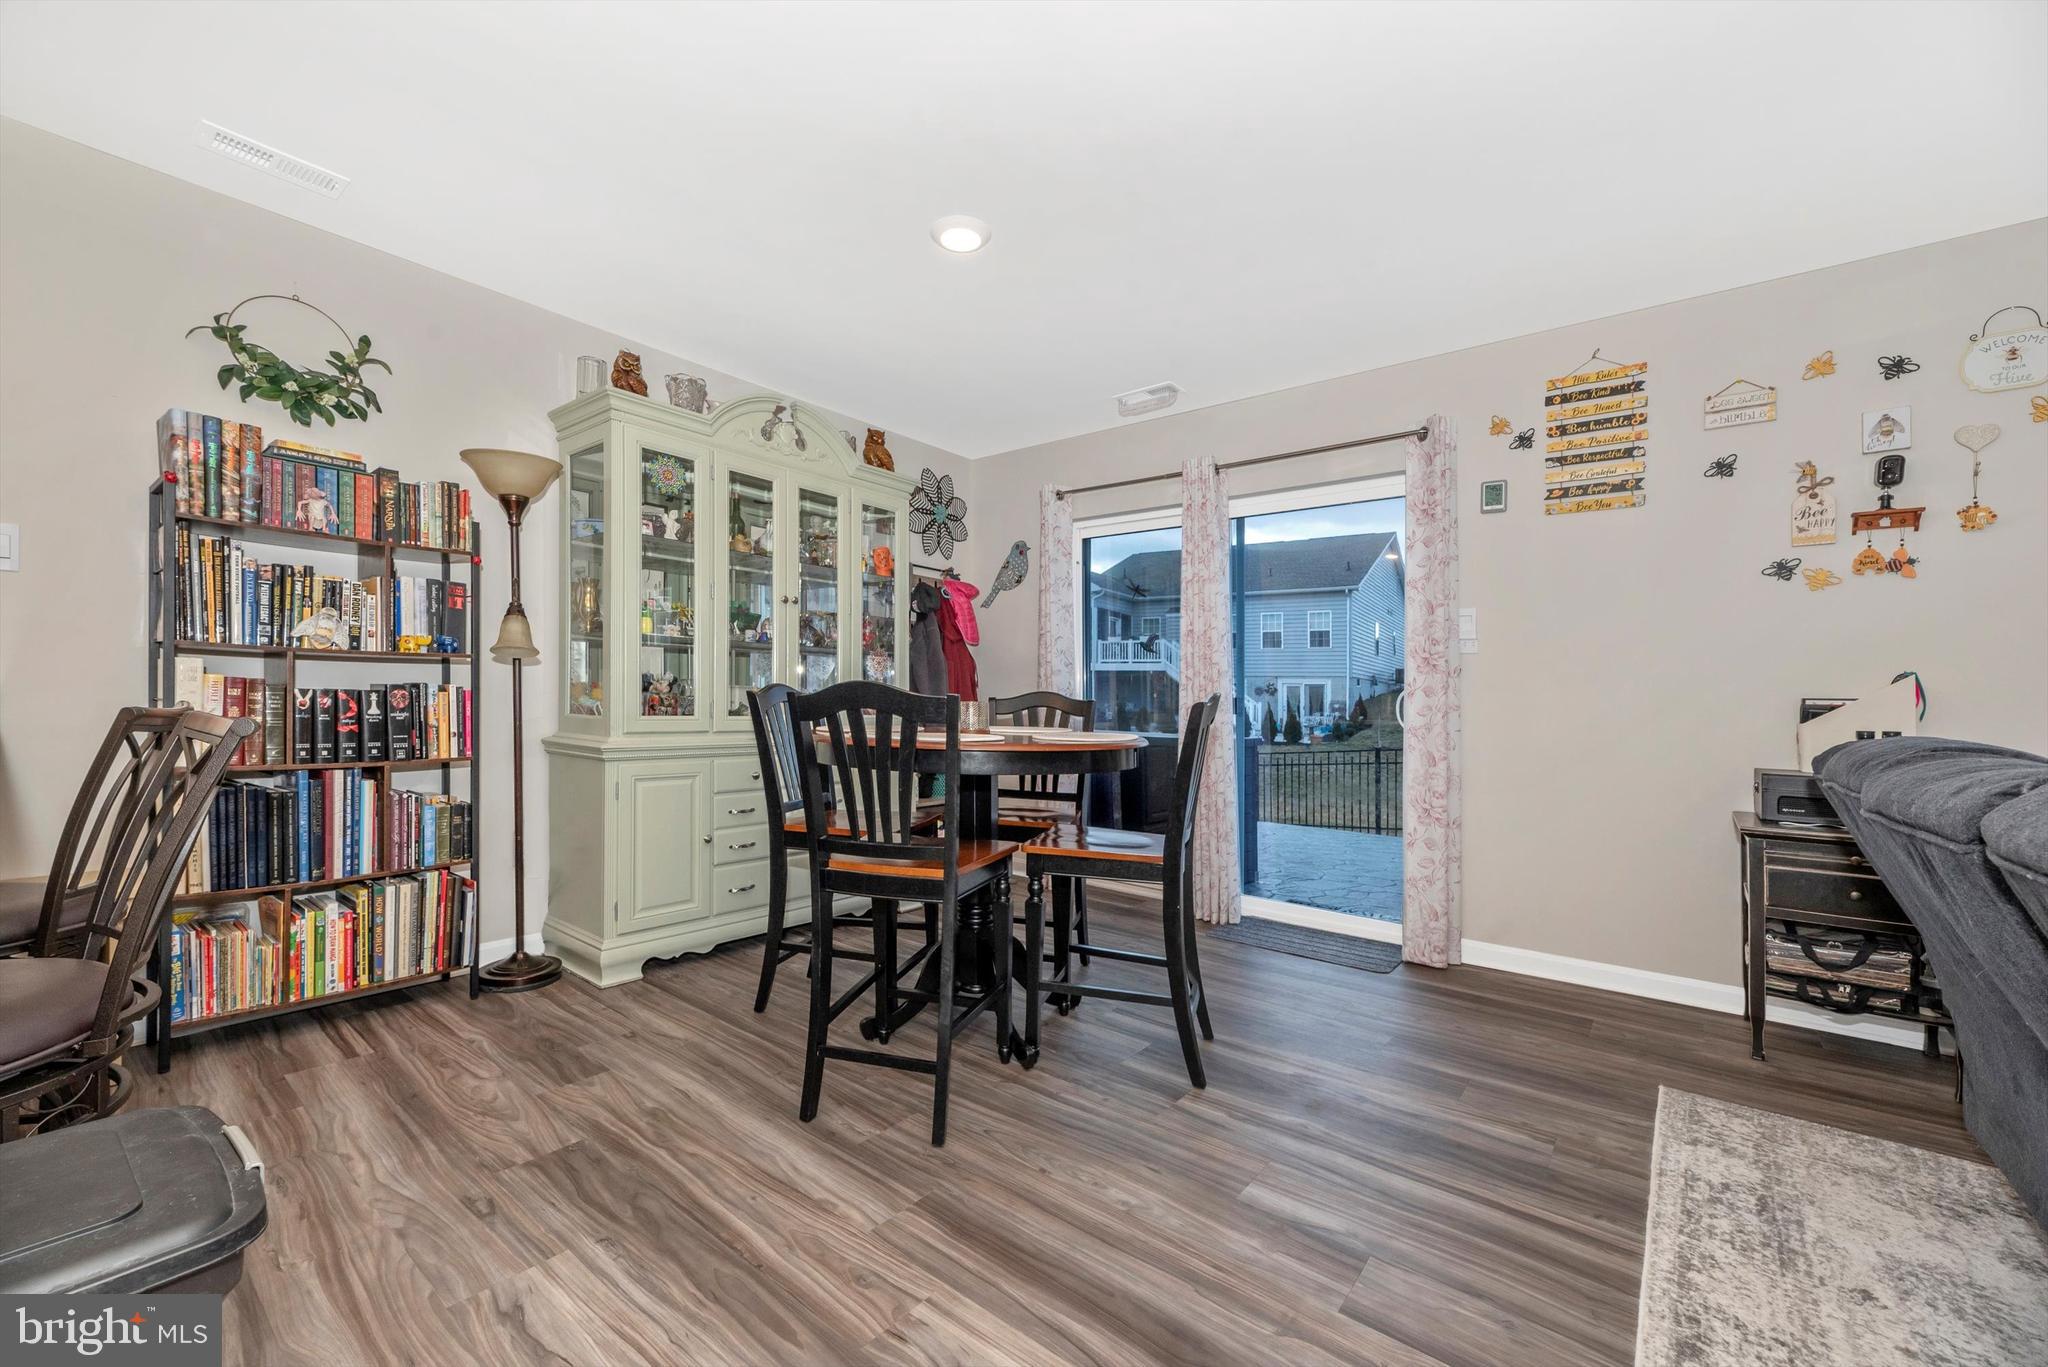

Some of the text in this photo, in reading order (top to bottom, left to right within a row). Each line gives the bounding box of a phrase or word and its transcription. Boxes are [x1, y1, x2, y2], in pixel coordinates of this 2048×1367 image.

[1979, 334, 2048, 353] WELCOME
[1595, 370, 1618, 381] Rules
[1989, 372, 2033, 385] Hive
[1570, 387, 1612, 402] Bee Kind
[1571, 400, 1622, 416] Bee Honest
[1566, 416, 1631, 434] Bee humble
[1565, 431, 1632, 450] Bee Positive
[1565, 449, 1624, 464] Bee Respectful
[1568, 466, 1617, 480] Bee Grateful
[1568, 486, 1584, 497] Bee
[1576, 499, 1612, 512] Bee You
[384, 500, 396, 530] NARNIA
[1794, 506, 1828, 521] Bee
[1808, 518, 1836, 529] HAPPY
[246, 572, 255, 602] PATERNO
[352, 583, 360, 596] DAN
[260, 584, 270, 624] PATERNO LEGACY
[352, 598, 360, 624] ROONEY
[376, 896, 384, 956] HOW WORLD?
